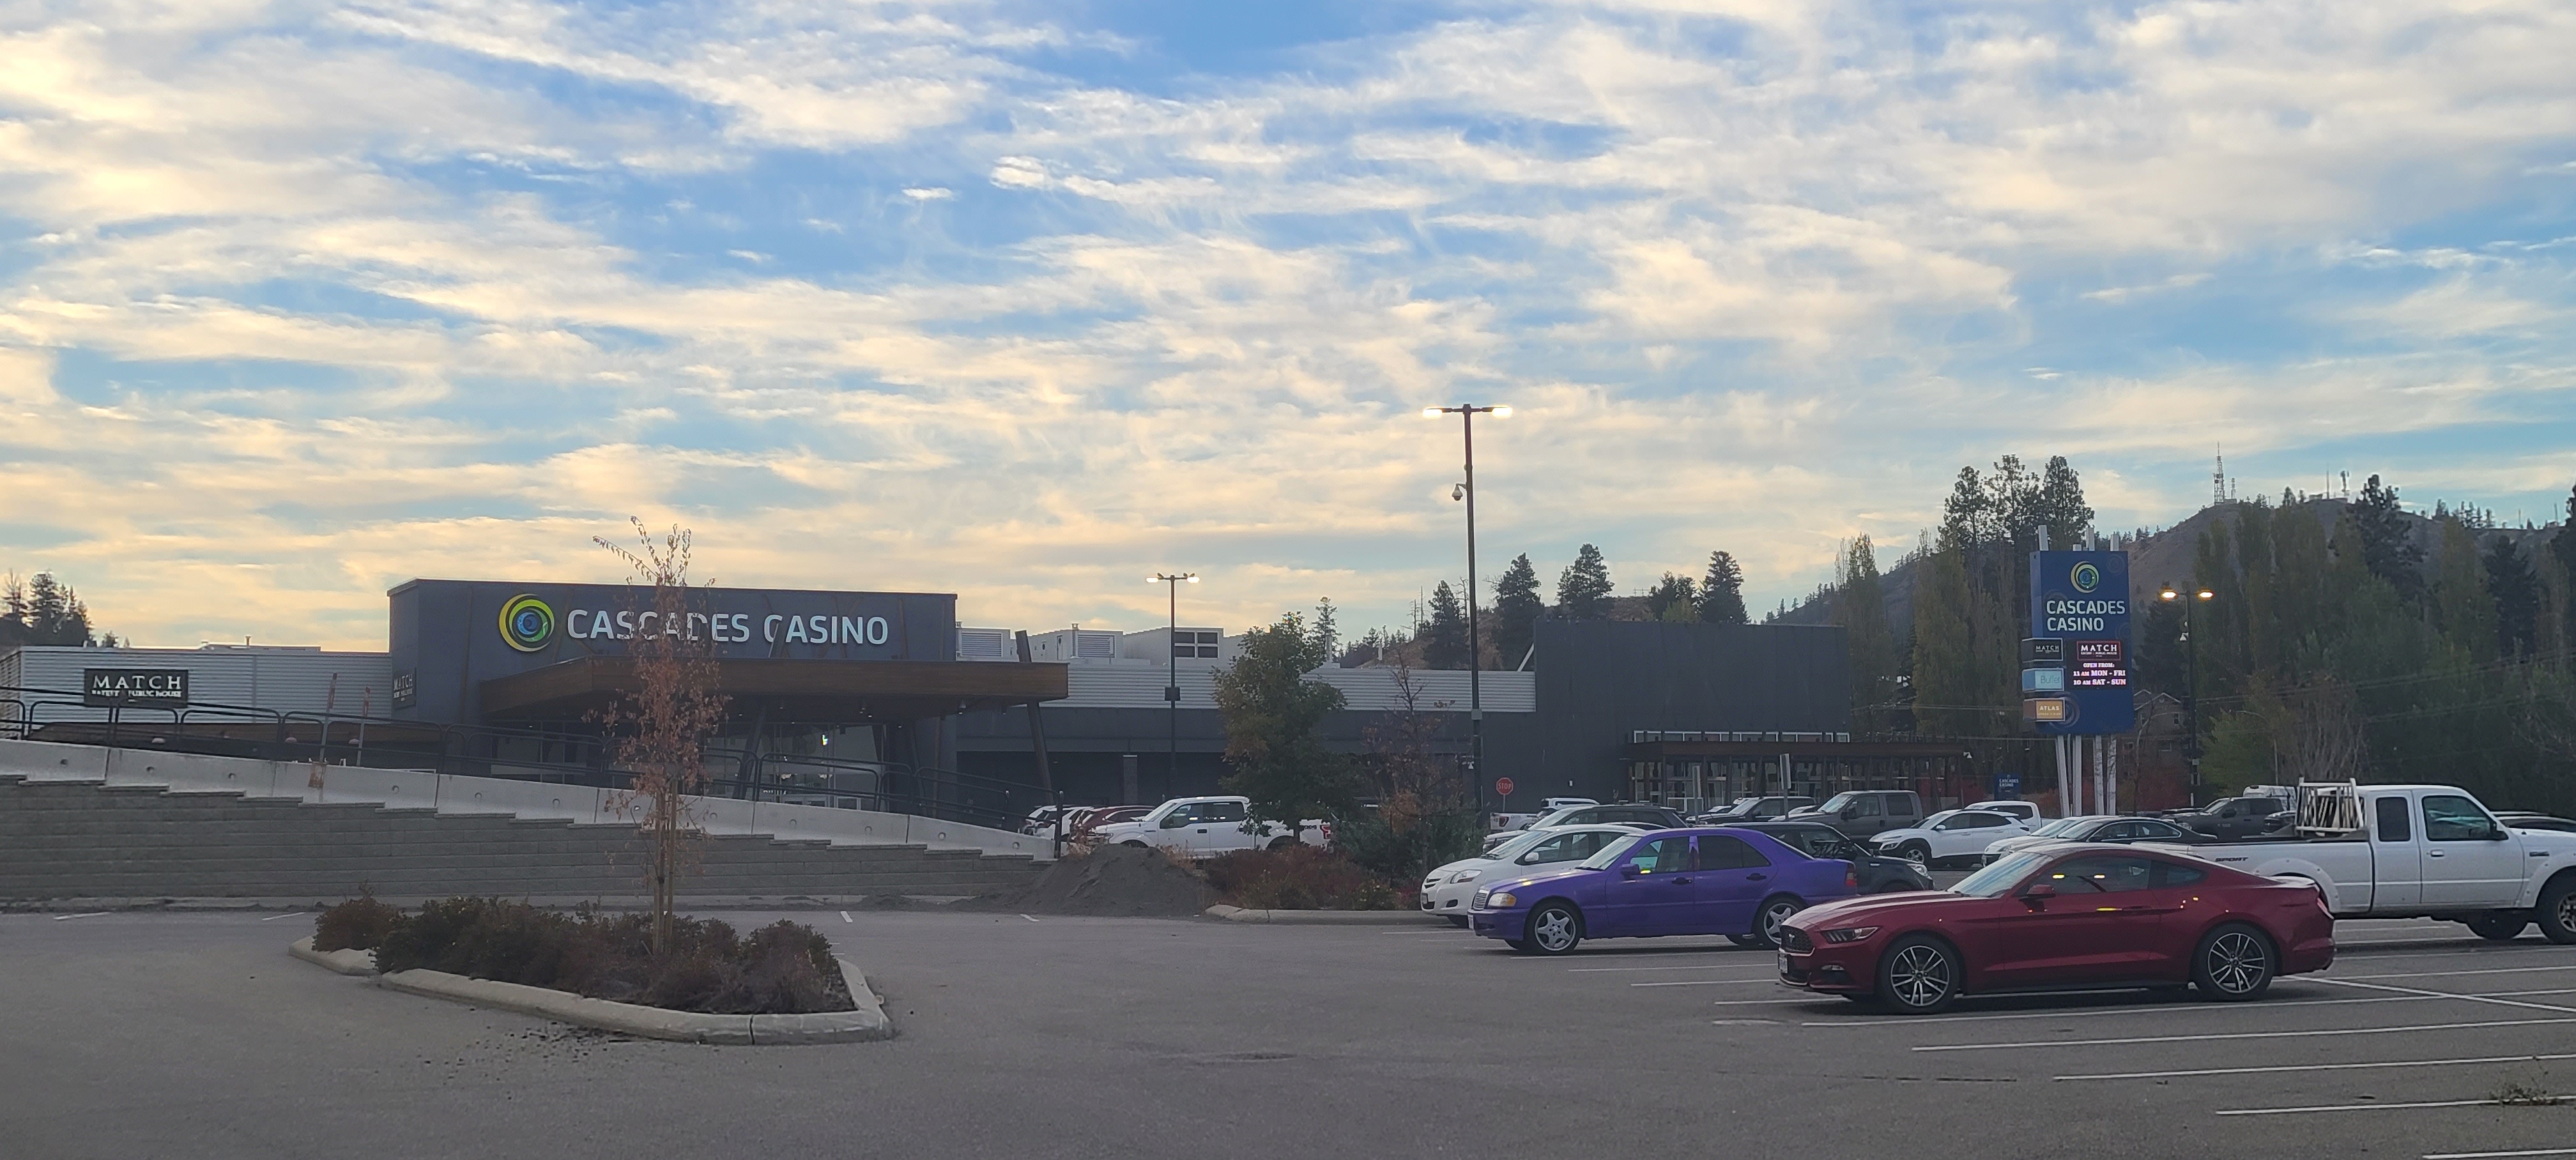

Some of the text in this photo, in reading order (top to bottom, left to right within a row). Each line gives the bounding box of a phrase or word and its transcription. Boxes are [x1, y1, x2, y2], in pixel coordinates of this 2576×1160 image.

[2046, 600, 2125, 614] CASCADES
[567, 609, 888, 645] CASCADES CASINO
[2047, 617, 2104, 631] CASINO
[93, 675, 181, 689] MATCH
[394, 673, 413, 691] MATCH
[2041, 675, 2060, 683] Buffet
